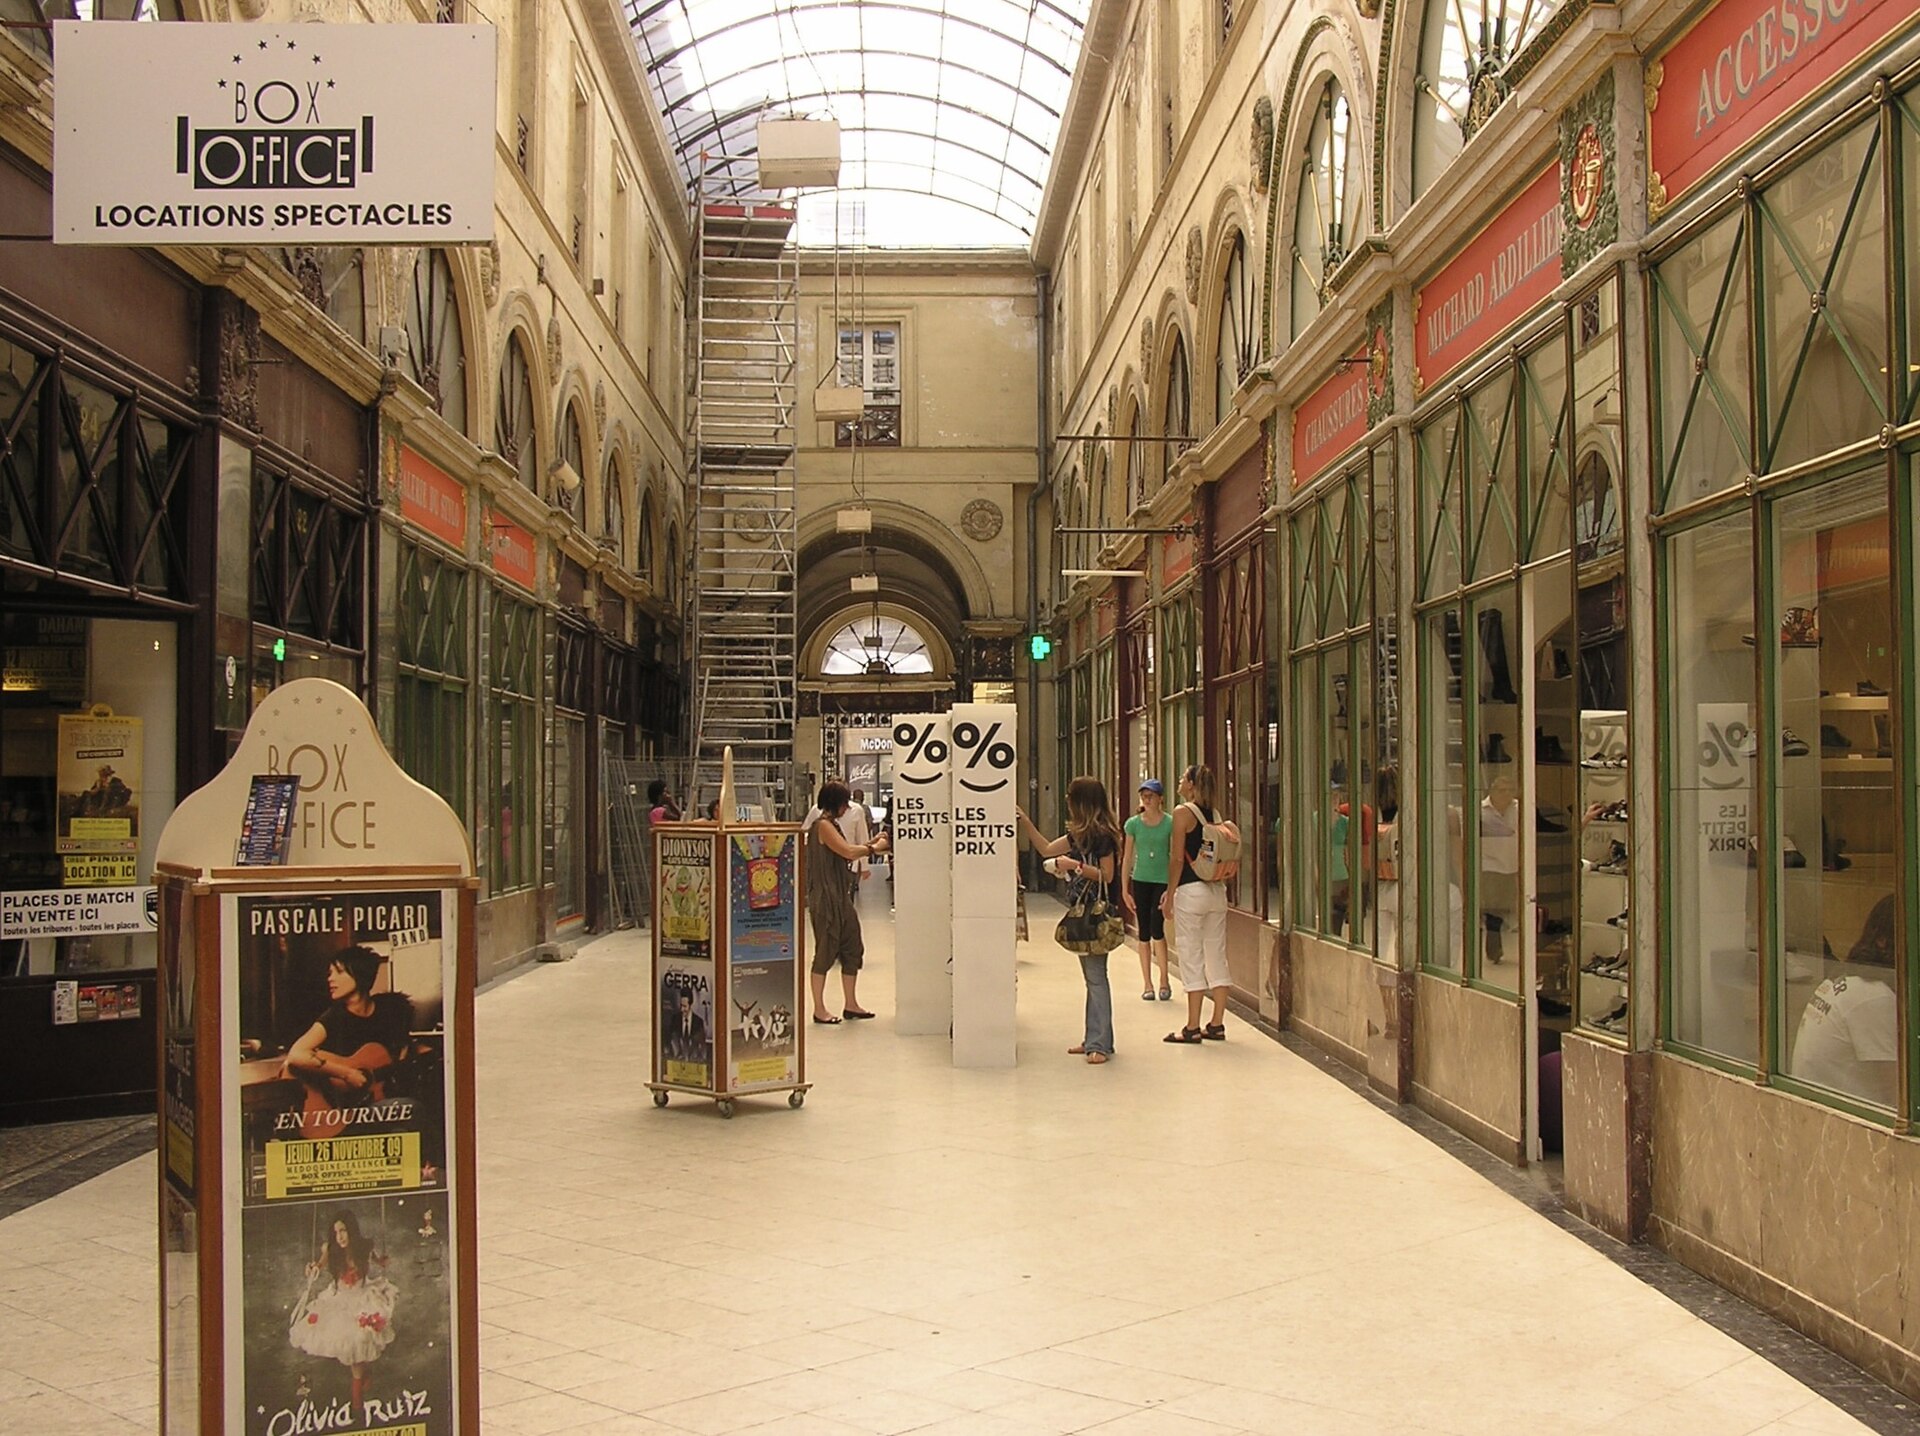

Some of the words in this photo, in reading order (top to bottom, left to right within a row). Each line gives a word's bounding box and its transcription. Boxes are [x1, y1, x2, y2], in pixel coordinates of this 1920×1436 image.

[235, 81, 320, 124] BOX
[199, 135, 352, 185] OFFICE
[95, 205, 264, 228] LOCATIONS
[274, 203, 453, 226] SPECTACLES
[1815, 207, 1835, 254] 25
[1427, 271, 1486, 356] MICHARD
[1304, 379, 1365, 456] CHAUSSURES
[268, 744, 348, 792] BOX
[897, 798, 924, 810] LES
[897, 812, 949, 825] PETITS
[955, 808, 986, 821] LES
[897, 828, 934, 840] PRIX
[955, 825, 1015, 838] PETITS
[663, 838, 710, 858] DIONYSOS
[955, 842, 996, 855] PRIX
[89, 855, 135, 863] PINDER
[65, 865, 116, 878] LOCATION
[122, 865, 136, 877] ICI
[4, 895, 59, 908] PLACES
[64, 894, 82, 905] DE
[87, 892, 134, 904] MATCH
[4, 912, 23, 924] EN
[28, 909, 76, 922] VENTE
[80, 908, 98, 920] ICI
[251, 908, 344, 936] PASCALE
[353, 904, 429, 931] PICARD
[4, 927, 28, 936] toutes
[30, 925, 41, 934] les
[43, 923, 73, 933] tribunes
[79, 923, 102, 932] toutes
[104, 922, 114, 931] les
[116, 921, 139, 931] places
[391, 929, 427, 947] BAND
[664, 972, 708, 993] GERRA
[276, 1110, 308, 1130] EN
[312, 1102, 414, 1127] TOURNÉE
[287, 1143, 314, 1164] JEUDI
[316, 1142, 330, 1161] 26
[332, 1138, 385, 1161] NOVEMBRE
[387, 1137, 401, 1157] 09
[301, 1172, 319, 1180] BOX
[321, 1170, 353, 1178] OFFICE
[267, 1396, 355, 1436] Olivia
